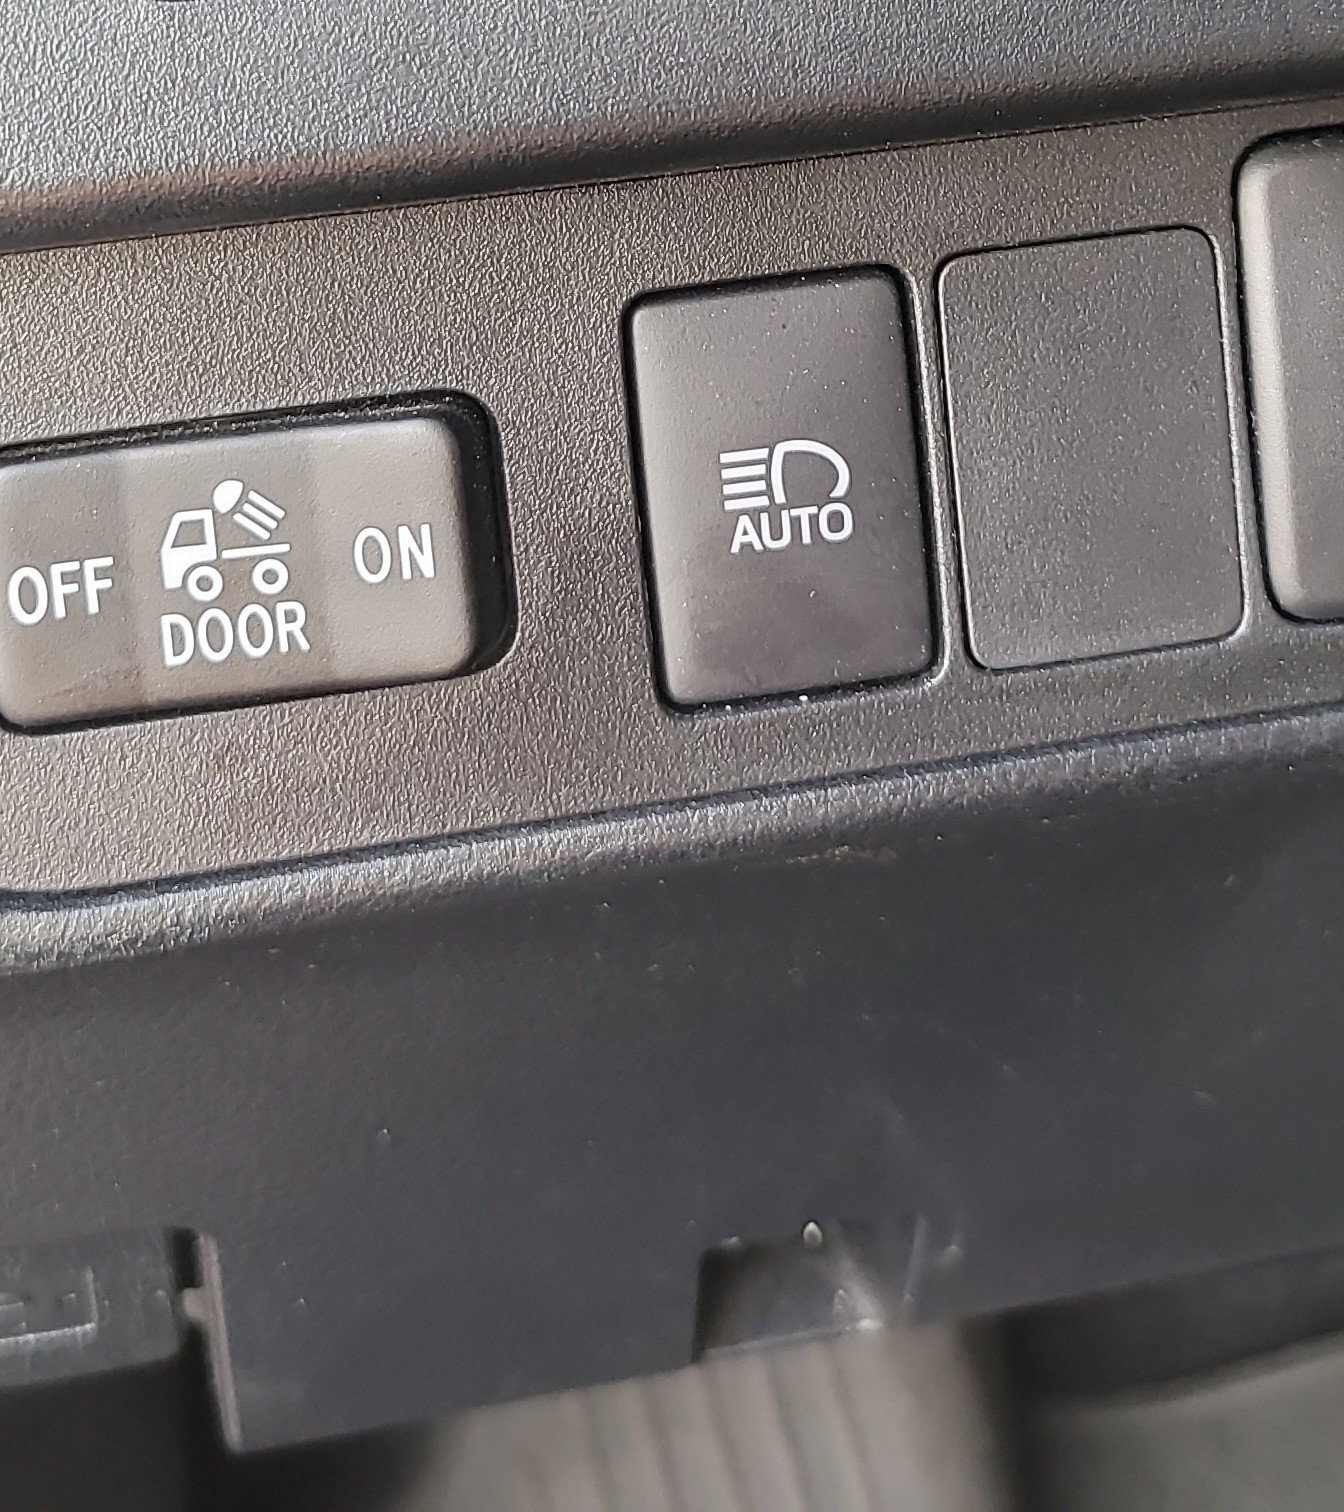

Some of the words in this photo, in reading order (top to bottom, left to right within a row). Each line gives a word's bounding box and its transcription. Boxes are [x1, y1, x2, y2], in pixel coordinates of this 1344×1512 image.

[729, 502, 854, 555] AUTO
[7, 556, 115, 626] OFF
[353, 522, 436, 584] ON
[160, 600, 311, 668] DOOR
